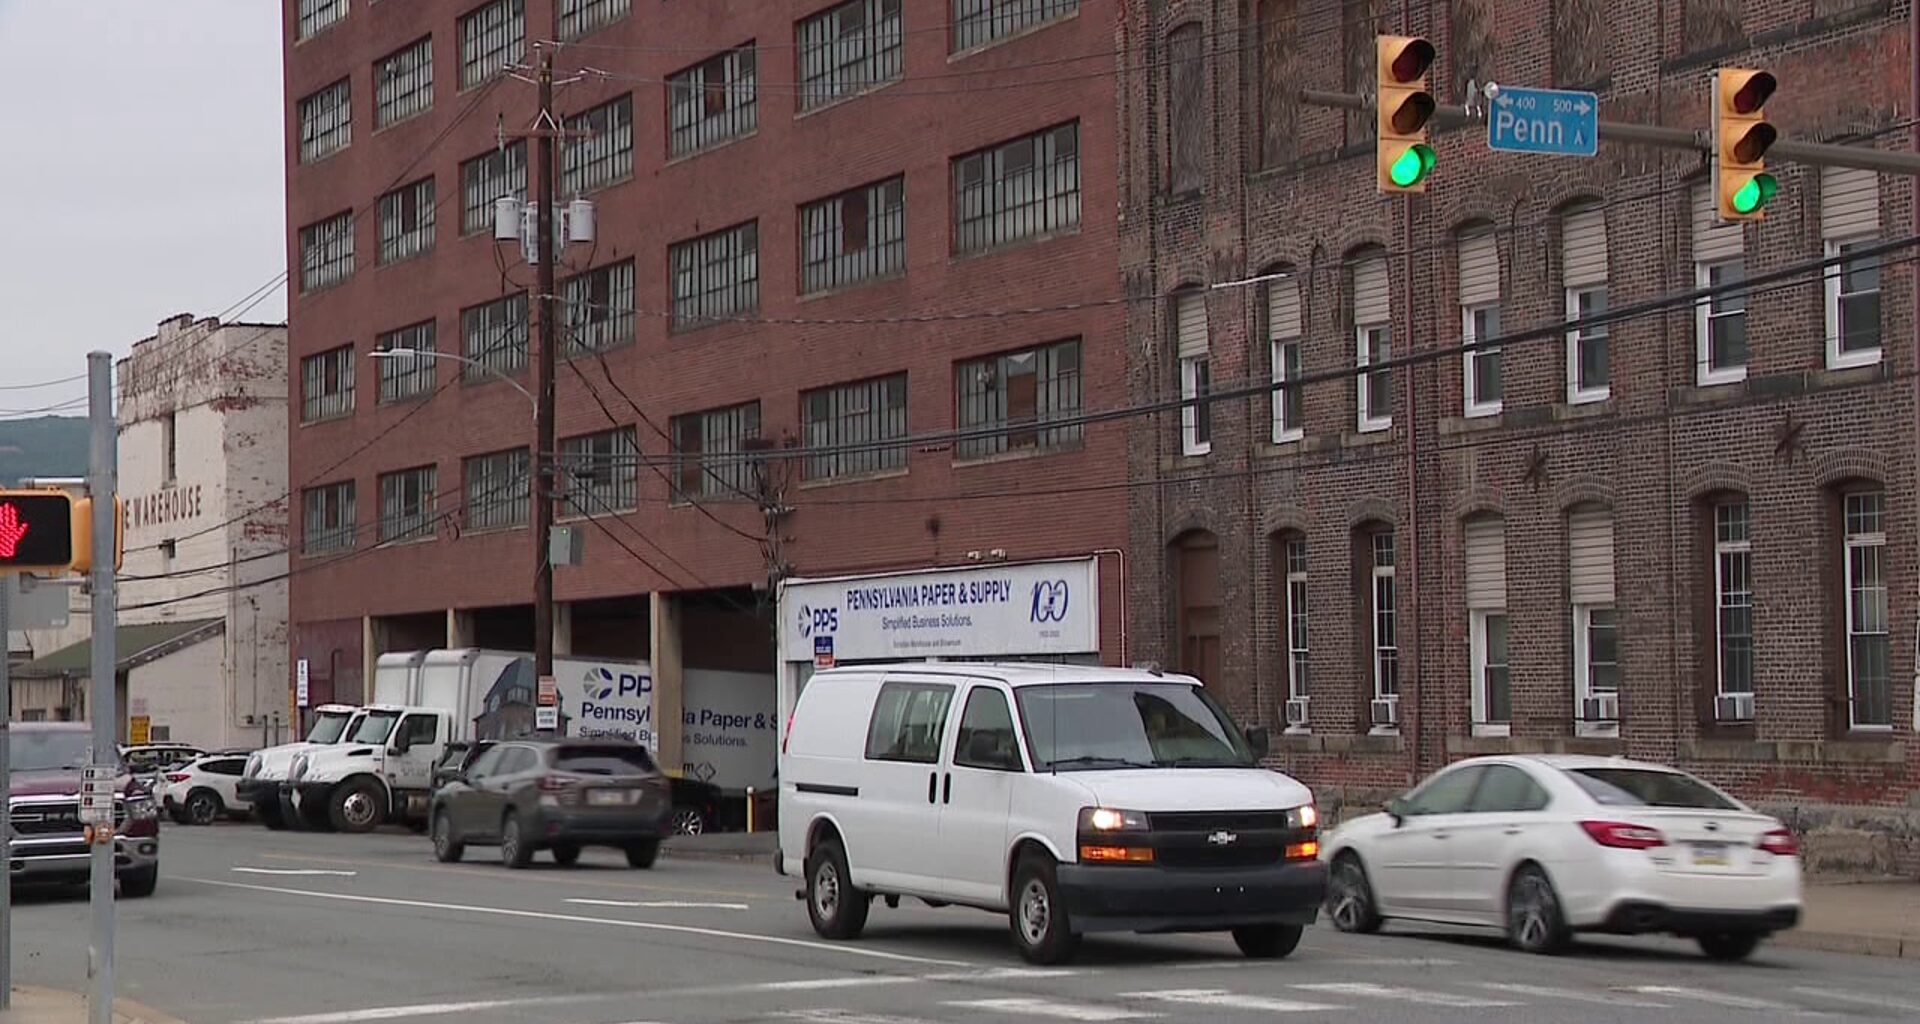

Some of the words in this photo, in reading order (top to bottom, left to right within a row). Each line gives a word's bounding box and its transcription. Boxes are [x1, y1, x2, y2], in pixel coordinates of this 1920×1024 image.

[1516, 96, 1536, 110] 400
[1553, 99, 1572, 112] 500
[1497, 111, 1563, 144] Penn
[133, 485, 201, 528] WAREHOUSE
[847, 586, 919, 611] PENNSYLVANIA
[922, 583, 956, 606] PAPER
[959, 582, 968, 604] &
[970, 579, 1011, 604] SUPPLY
[813, 608, 838, 632] PPS
[912, 614, 940, 628] Business
[619, 673, 652, 697] PP
[700, 709, 751, 730] Paper
[754, 713, 766, 729] &
